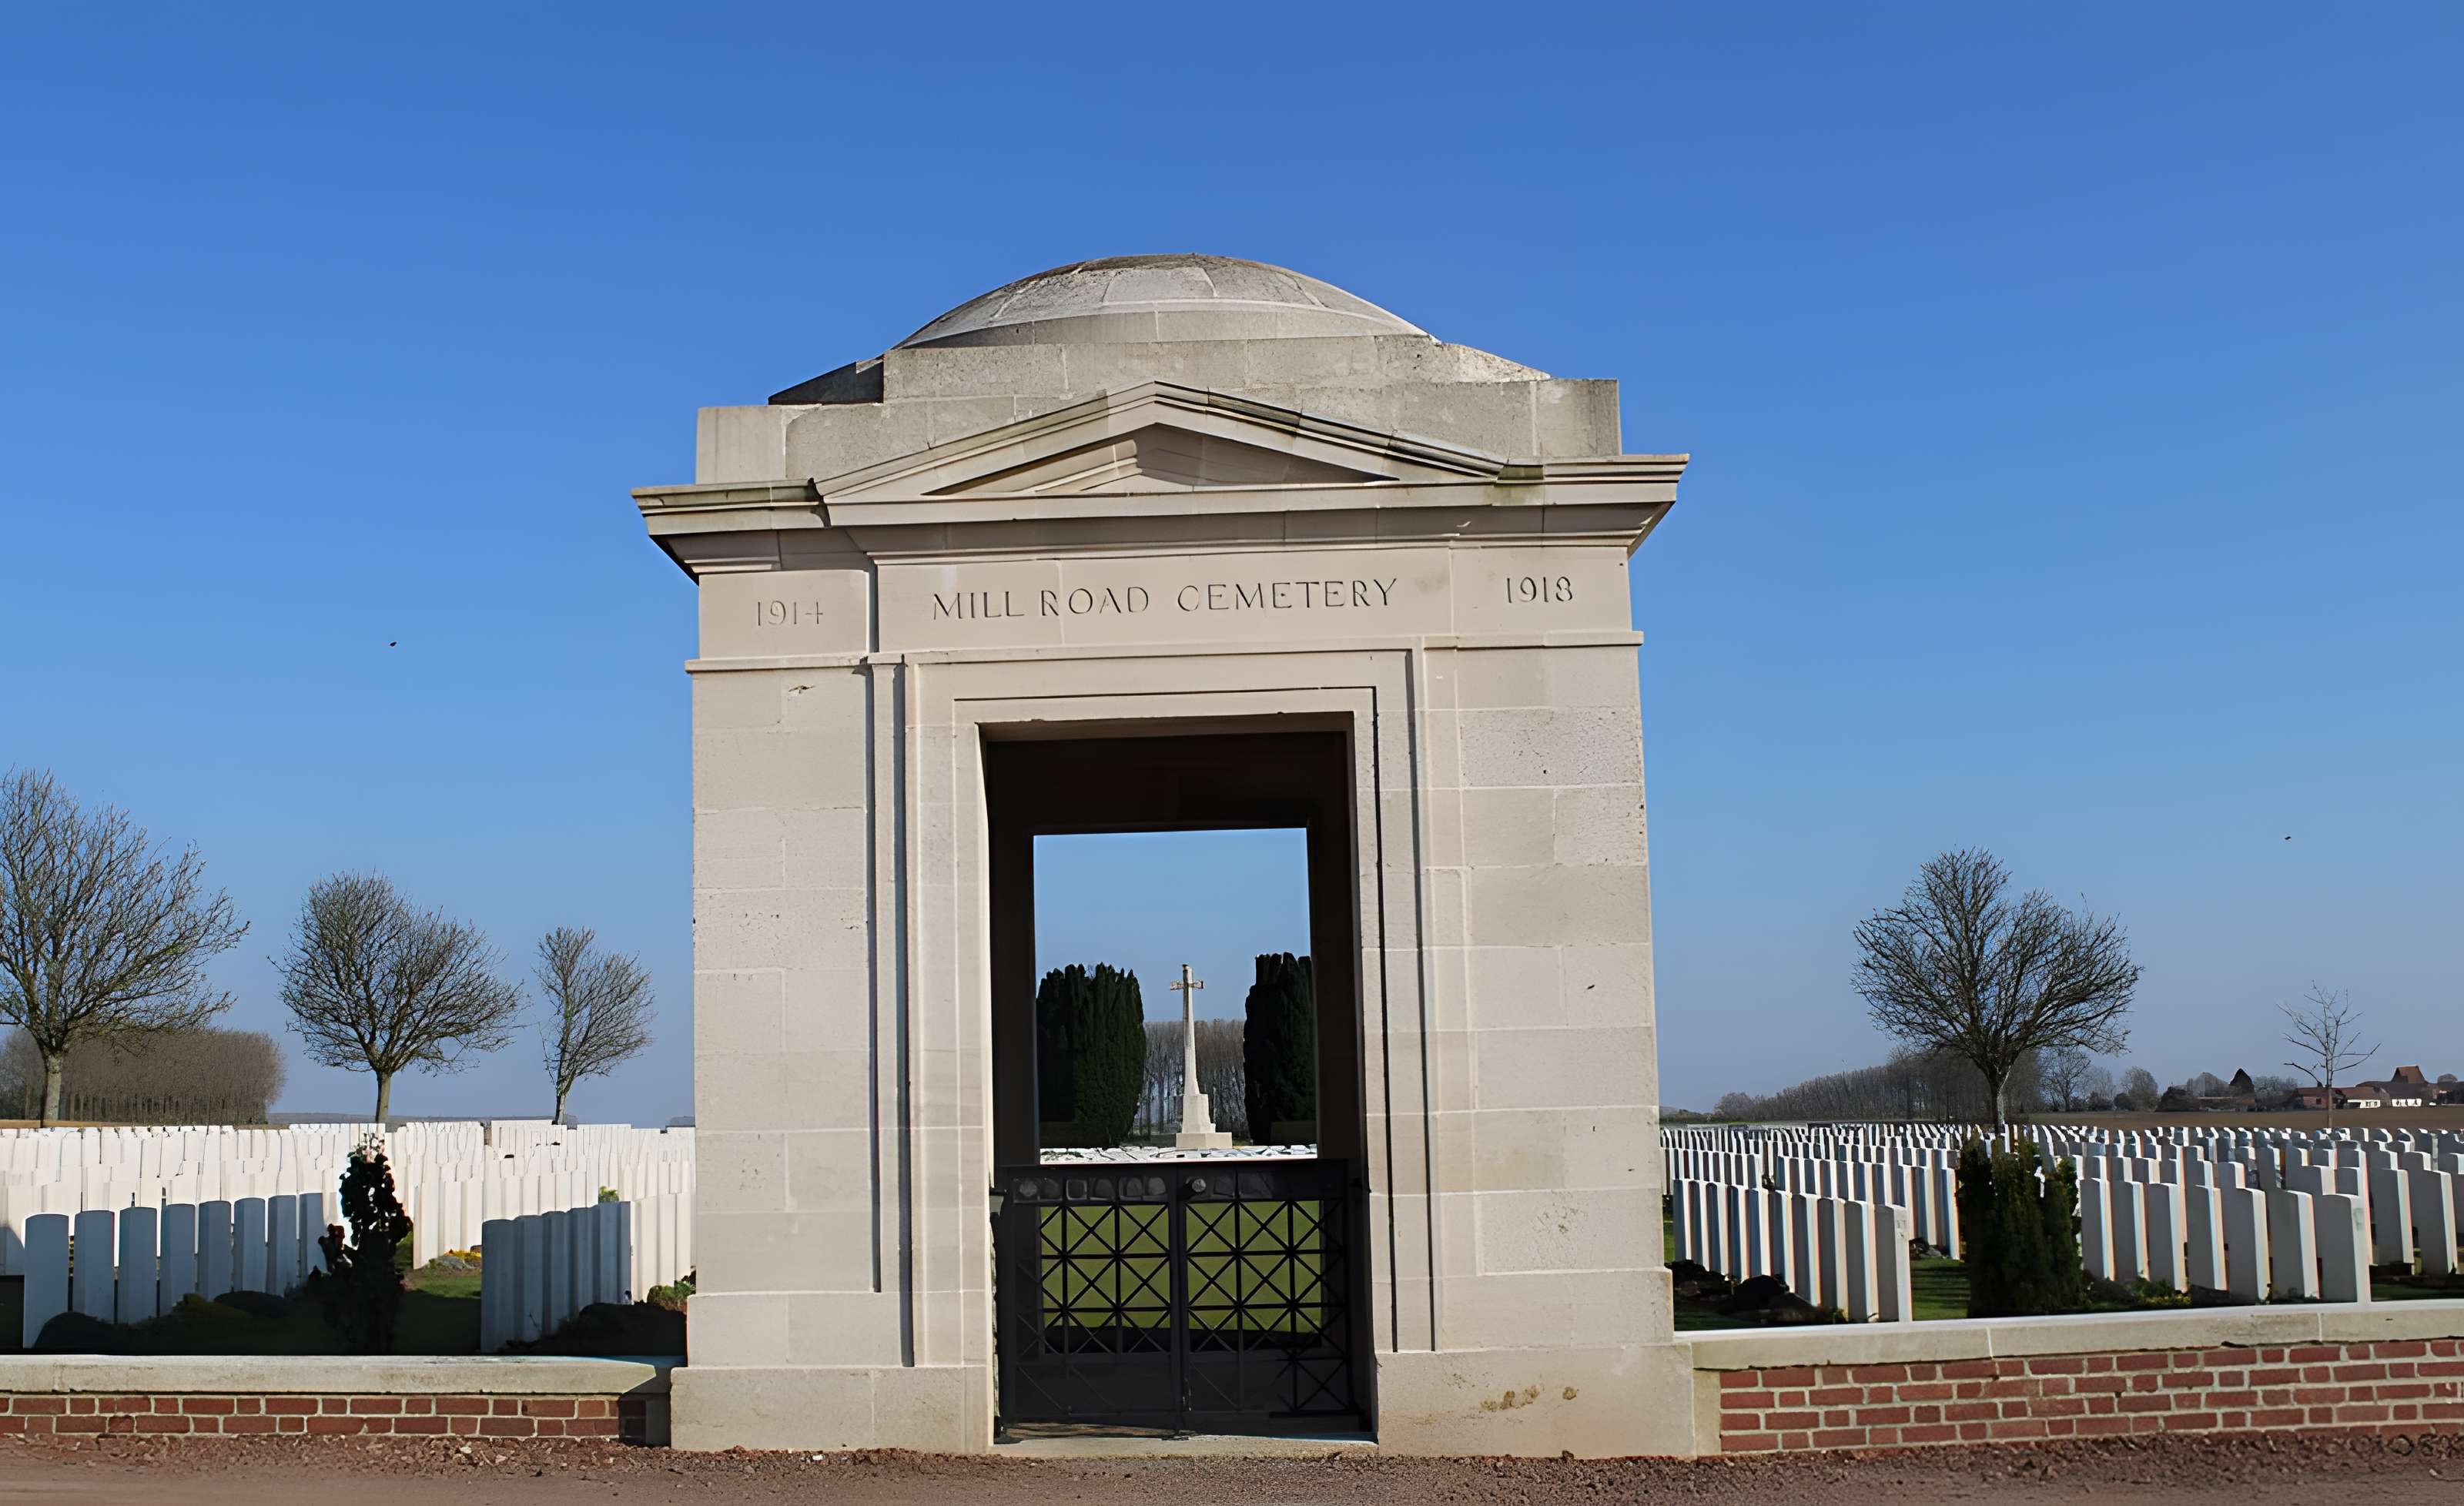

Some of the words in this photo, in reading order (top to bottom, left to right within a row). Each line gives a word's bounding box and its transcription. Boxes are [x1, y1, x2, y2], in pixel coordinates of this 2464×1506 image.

[933, 591, 1024, 620] MILL
[1040, 586, 1150, 617] ROAD
[1177, 578, 1397, 611] CEMETERY
[1506, 576, 1573, 604] 1918
[757, 600, 823, 626] 1914
